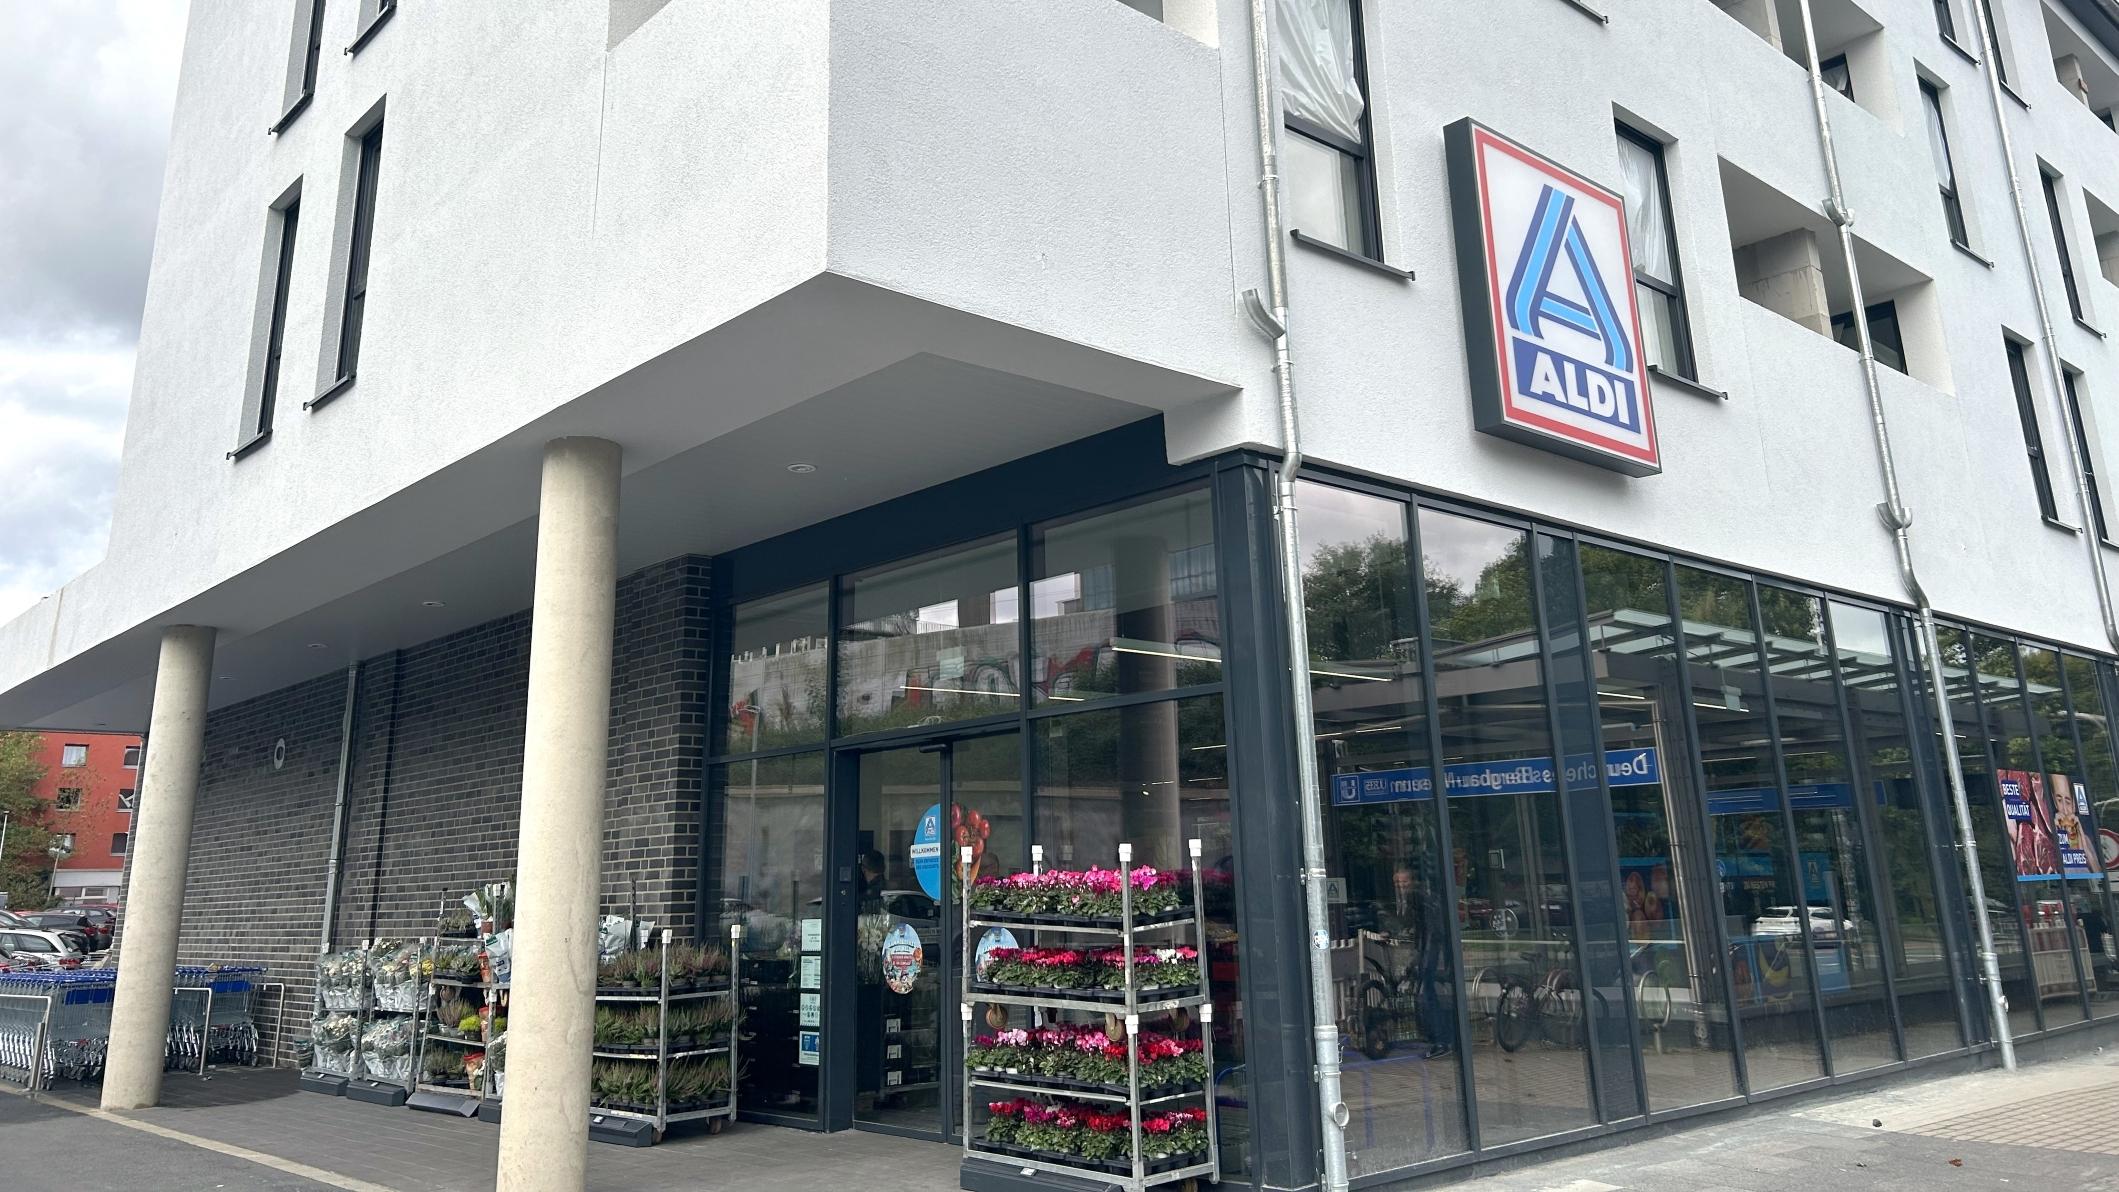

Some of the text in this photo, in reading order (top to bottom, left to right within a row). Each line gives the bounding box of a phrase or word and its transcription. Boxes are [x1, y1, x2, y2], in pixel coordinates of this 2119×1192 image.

[1529, 351, 1630, 425] ALDI
[2002, 783, 2020, 796] BESTE
[2006, 801, 2030, 816] QUALITÄT
[2057, 833, 2069, 845] ZUM
[911, 846, 939, 855] WILLKOMMEN
[2073, 853, 2087, 865] PREIS
